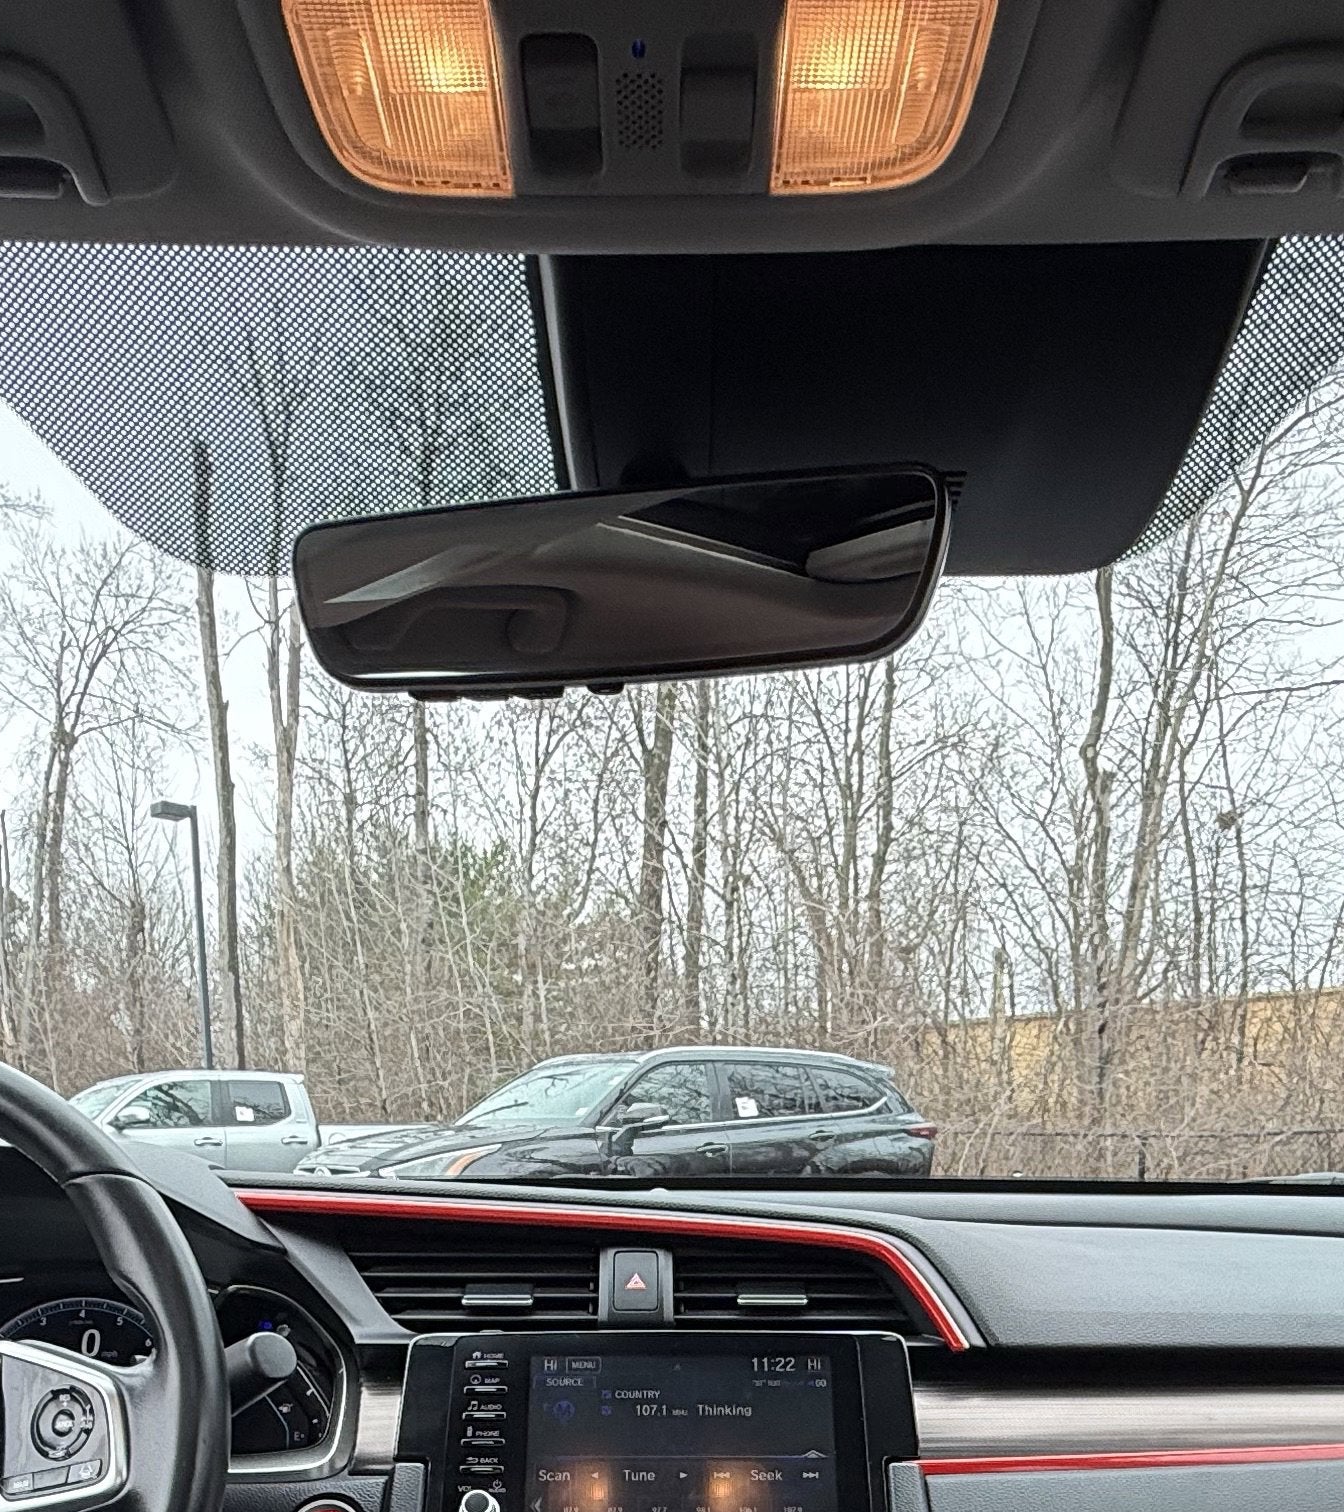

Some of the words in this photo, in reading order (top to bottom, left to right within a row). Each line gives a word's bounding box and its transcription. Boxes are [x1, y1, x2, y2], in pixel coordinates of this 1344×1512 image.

[79, 1309, 86, 1318] 4
[39, 1317, 47, 1326] 3
[116, 1317, 124, 1326] 5
[81, 1328, 101, 1357] 0
[144, 1338, 152, 1347] 6
[571, 1360, 596, 1369] MENU
[751, 1357, 796, 1372] 11:22
[545, 1378, 584, 1387] SOURCE
[614, 1390, 661, 1399] COUNTRY
[635, 1404, 667, 1417] 107.1
[697, 1404, 753, 1417] Thinking
[293, 1431, 301, 1441] E
[538, 1469, 571, 1482] Scan
[623, 1469, 656, 1482] Tune
[750, 1469, 783, 1481] Seek
